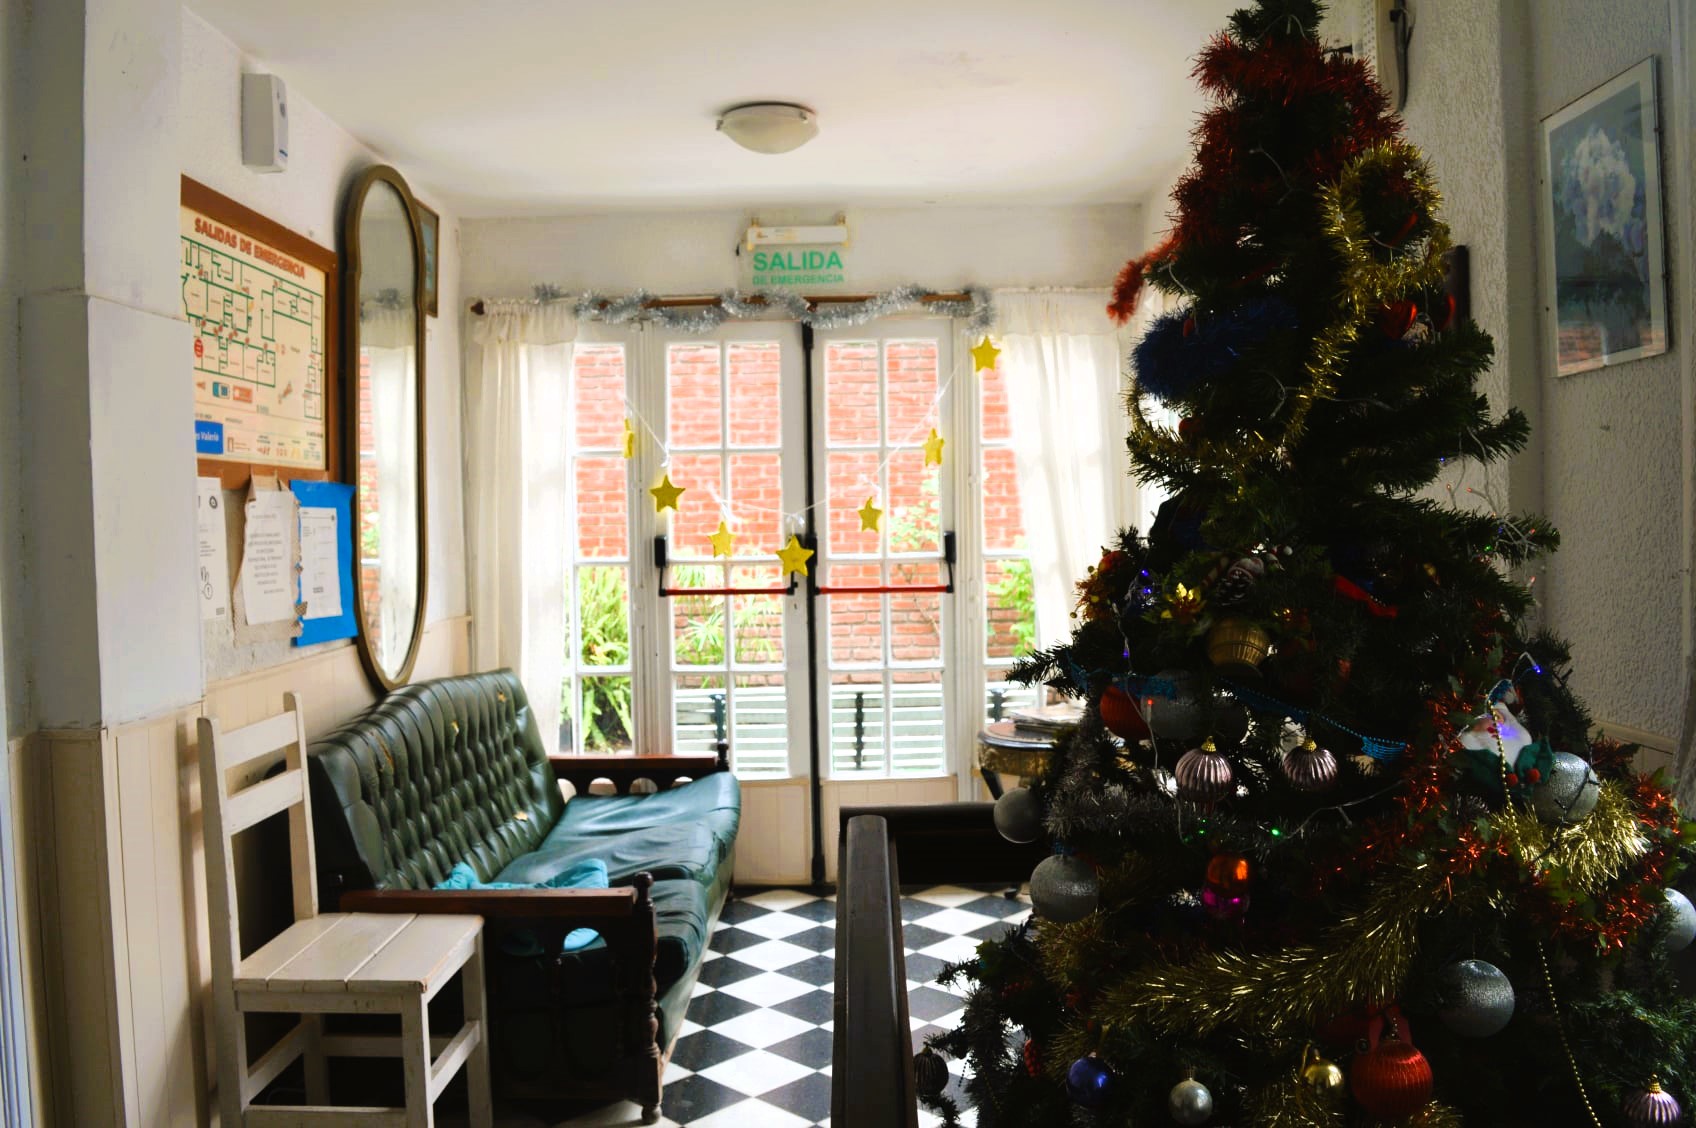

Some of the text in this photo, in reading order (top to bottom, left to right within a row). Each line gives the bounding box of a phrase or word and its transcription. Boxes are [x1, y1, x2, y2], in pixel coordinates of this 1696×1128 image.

[195, 217, 305, 280] SALIDAS DE EMERGENCIA
[753, 251, 843, 271] SALIDA
[752, 273, 844, 286] DE EMERGENCIA
